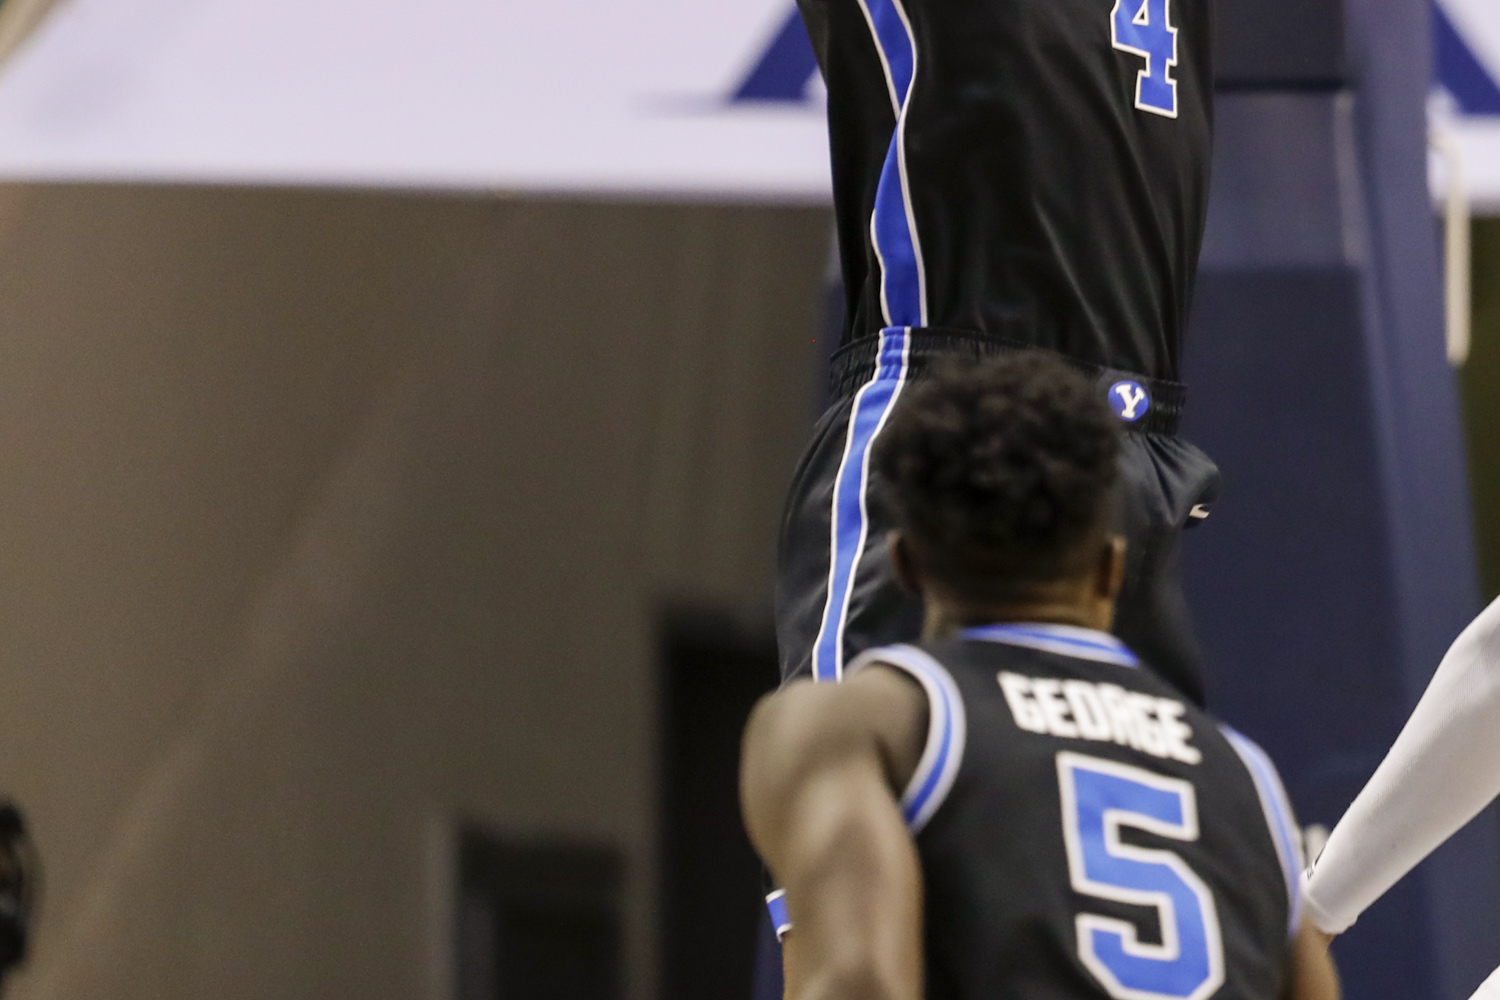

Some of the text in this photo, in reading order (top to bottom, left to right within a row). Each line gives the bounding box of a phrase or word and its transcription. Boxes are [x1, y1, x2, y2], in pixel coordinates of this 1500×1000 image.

[1115, 384, 1146, 419] Y
[997, 670, 1203, 766] GEORGE
[1055, 750, 1226, 1000] 5
